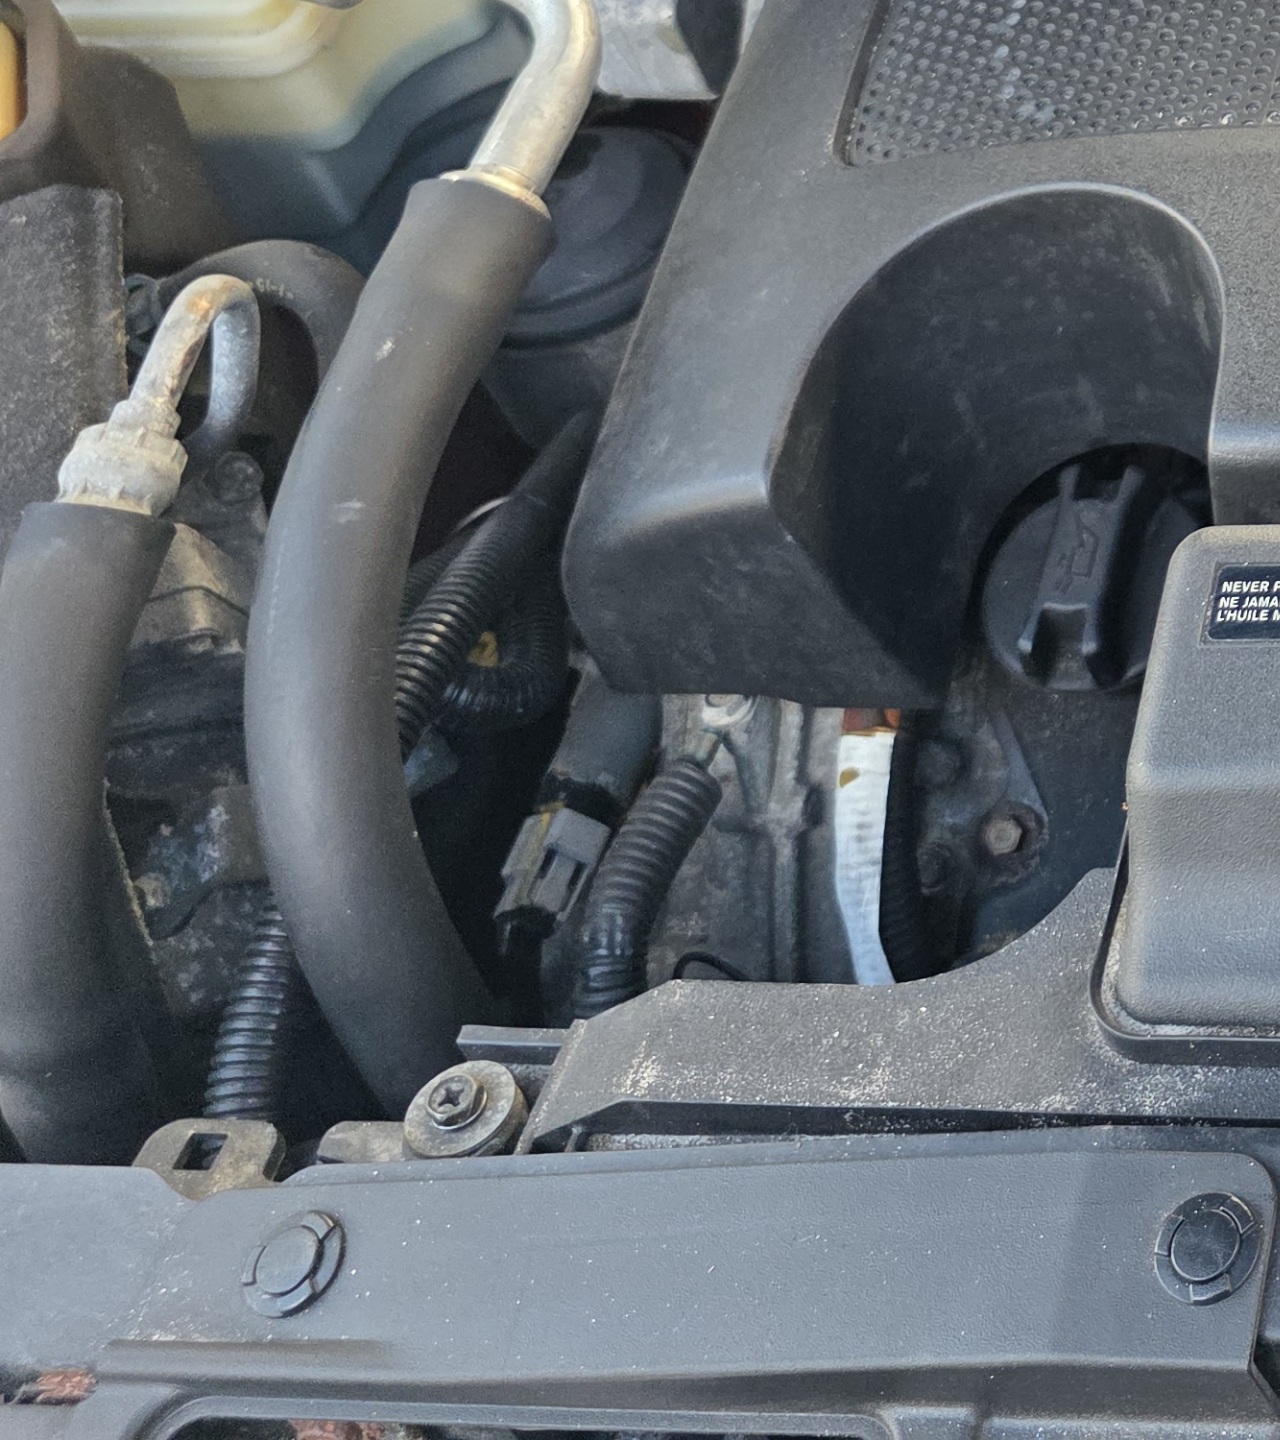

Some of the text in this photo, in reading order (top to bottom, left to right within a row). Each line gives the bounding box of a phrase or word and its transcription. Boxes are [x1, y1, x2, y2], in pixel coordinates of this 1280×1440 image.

[1221, 580, 1270, 593] NEVER
[1218, 596, 1239, 609] NE
[1216, 609, 1269, 622] L'HUILE
